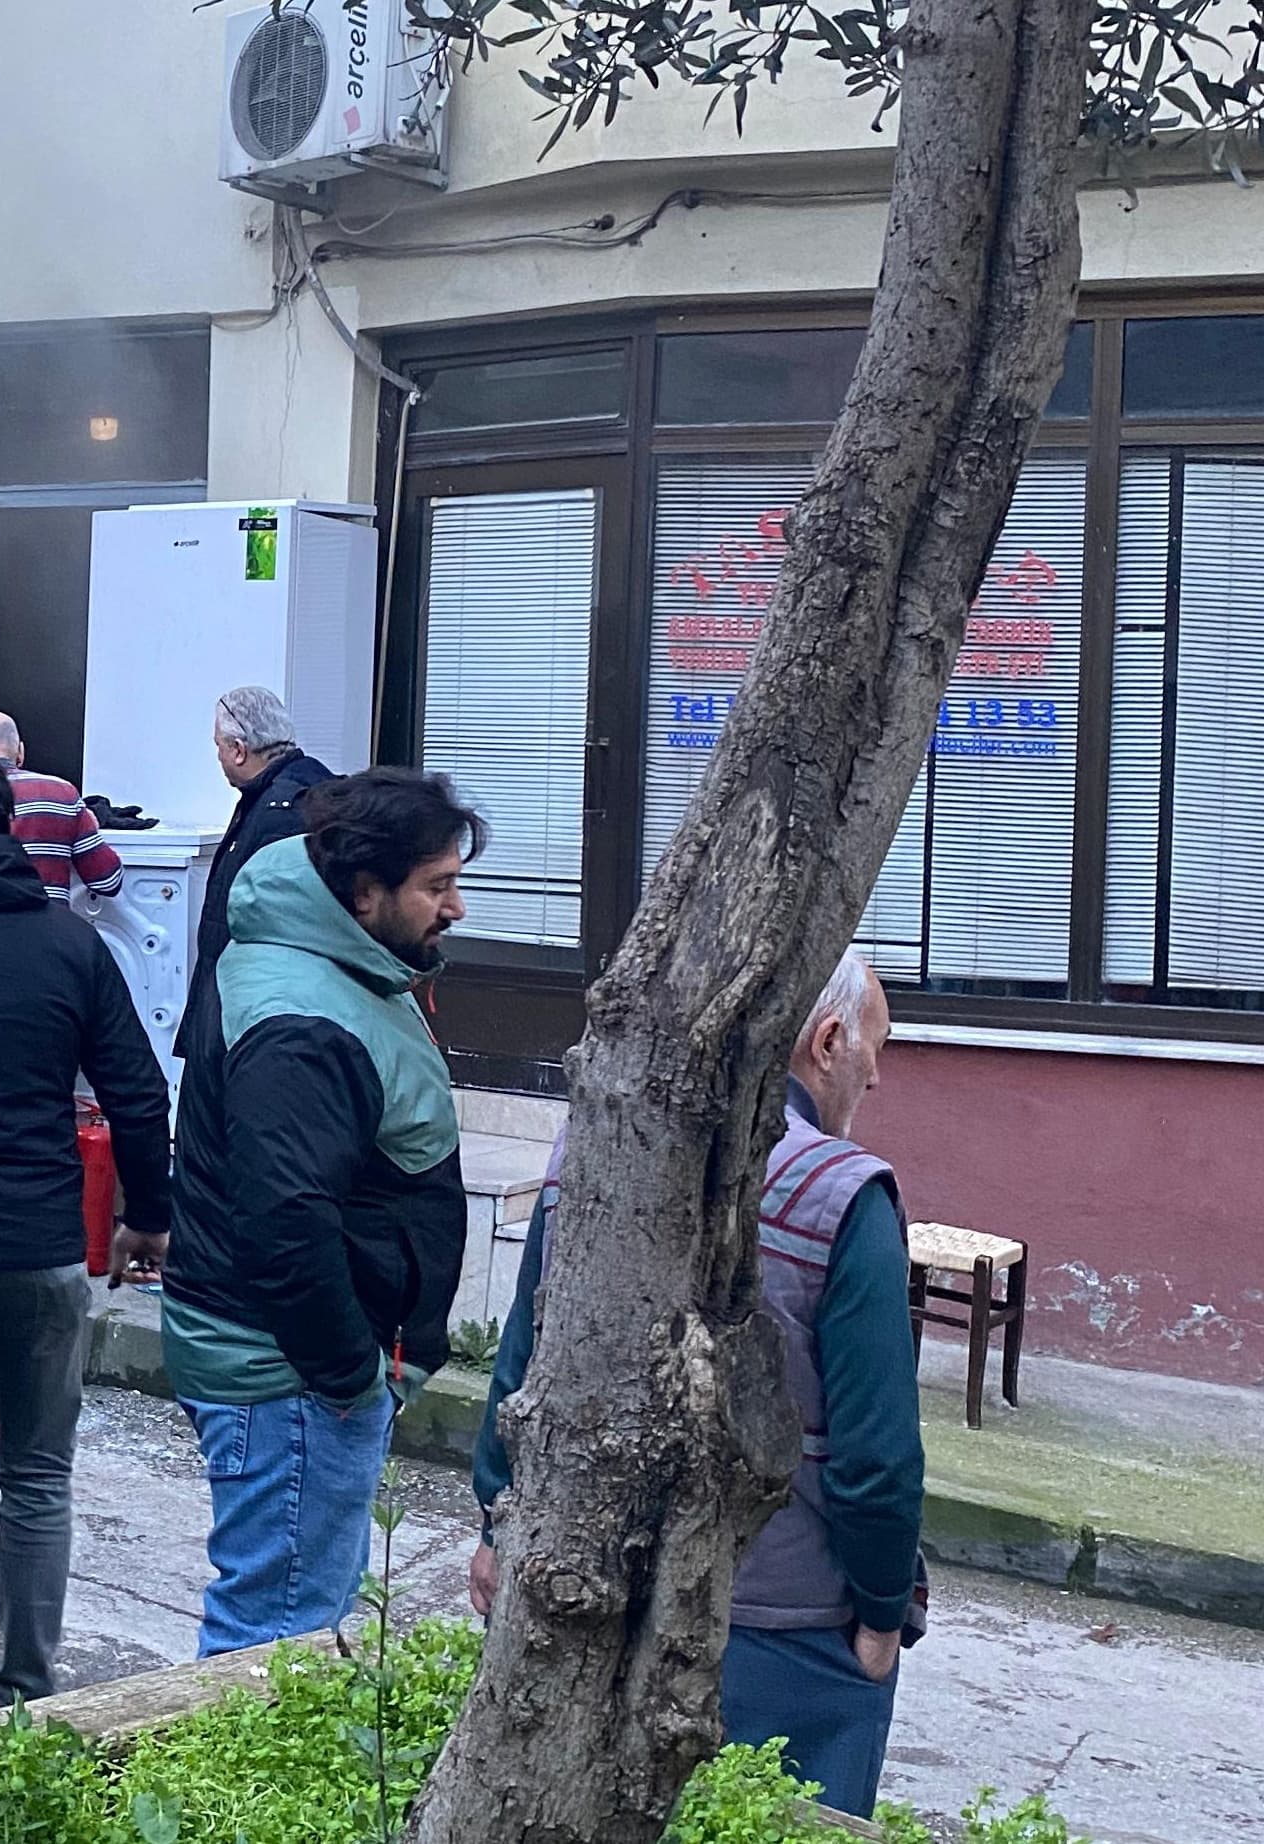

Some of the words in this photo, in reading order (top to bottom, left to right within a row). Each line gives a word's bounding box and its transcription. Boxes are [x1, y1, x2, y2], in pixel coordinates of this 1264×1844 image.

[670, 694, 714, 721] Tel
[967, 699, 1003, 728] 13
[1016, 700, 1056, 729] 53
